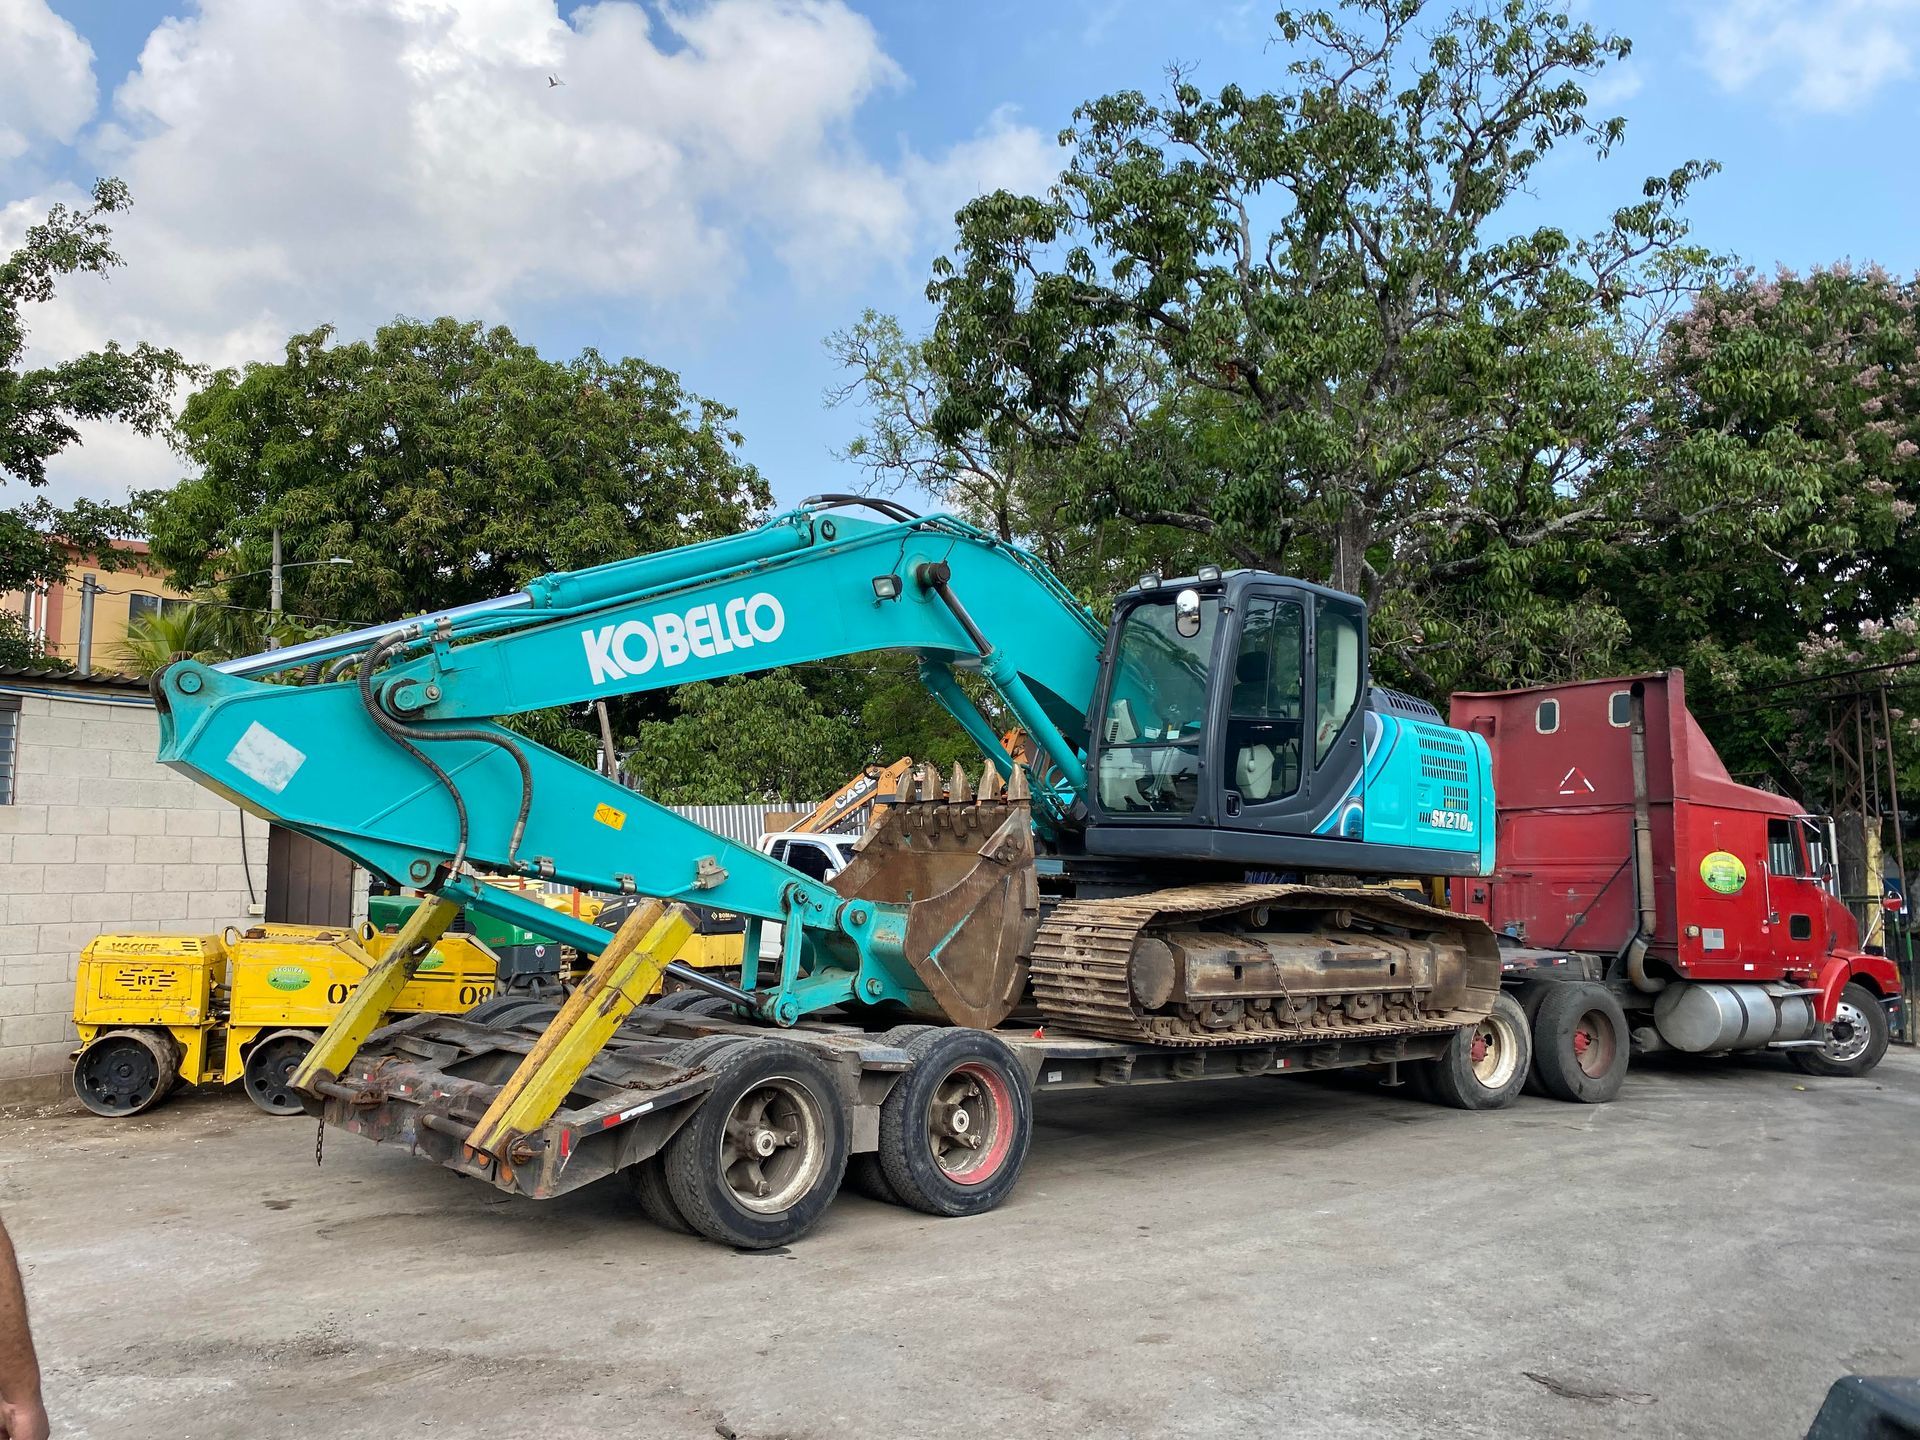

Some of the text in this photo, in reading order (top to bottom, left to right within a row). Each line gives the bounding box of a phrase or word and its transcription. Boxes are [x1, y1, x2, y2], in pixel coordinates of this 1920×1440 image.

[581, 592, 785, 685] KOBELCO
[834, 776, 877, 809] CASE
[138, 976, 155, 985] RT
[459, 986, 491, 1005] 08
